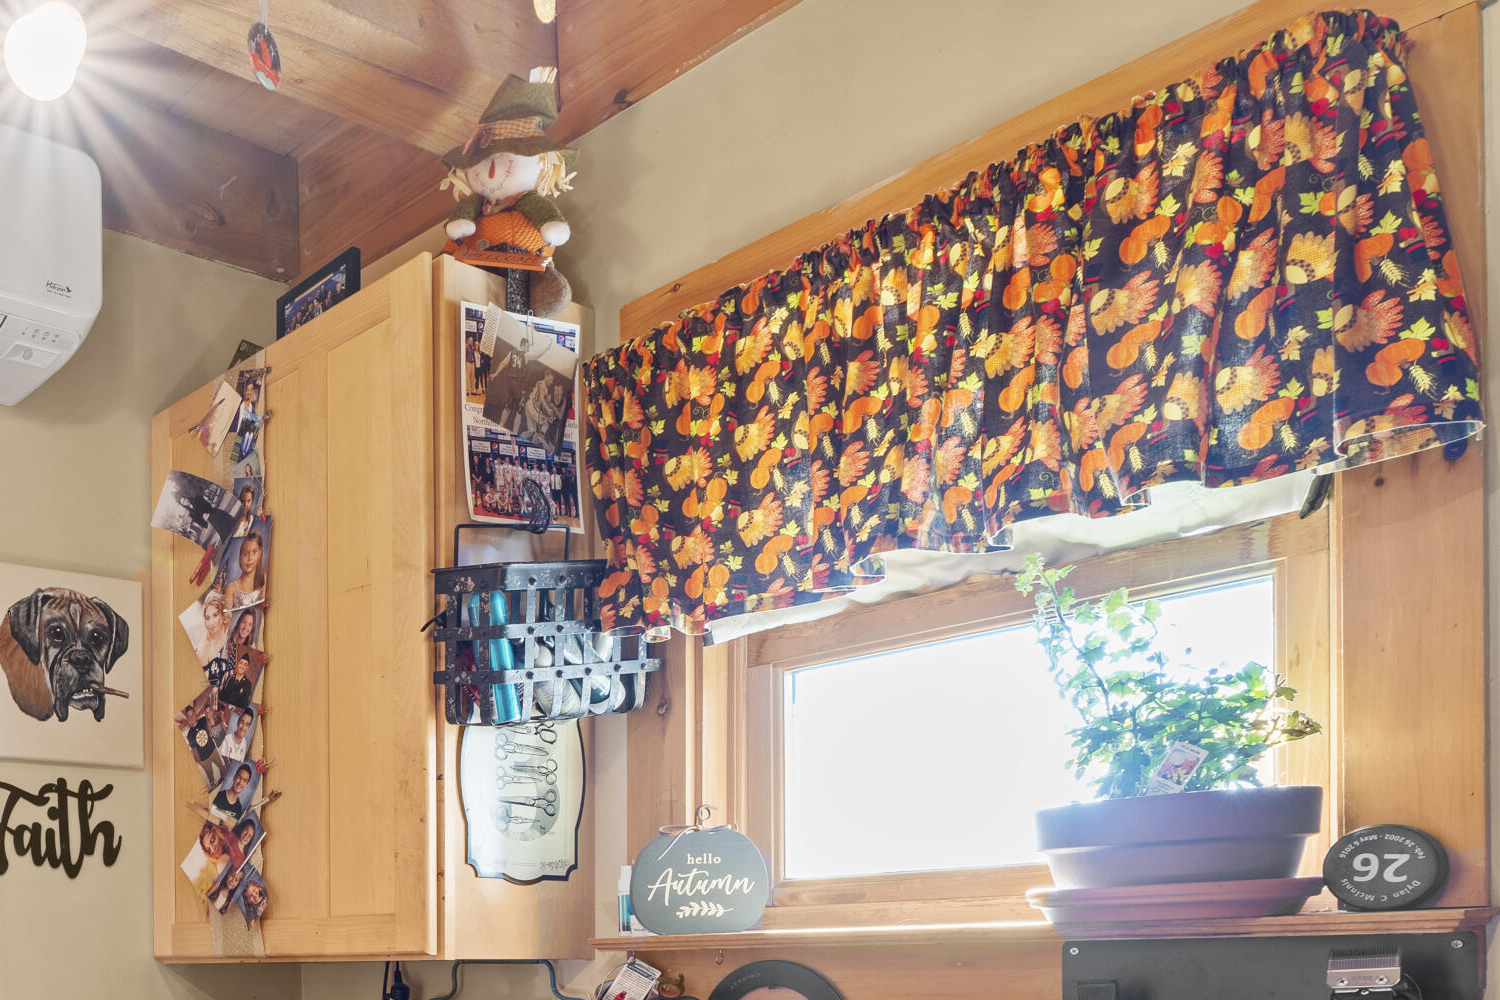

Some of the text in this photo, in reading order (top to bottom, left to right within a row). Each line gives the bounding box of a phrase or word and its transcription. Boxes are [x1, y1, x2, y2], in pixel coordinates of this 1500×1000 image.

[1360, 834, 1378, 843] May
[1384, 833, 1405, 843] 2002
[1404, 839, 1415, 848] 26
[1339, 844, 1355, 858] 2016
[686, 853, 722, 865] hello
[1352, 852, 1410, 882] 26
[647, 867, 755, 906] Autumn
[1393, 880, 1421, 898] Dylan
